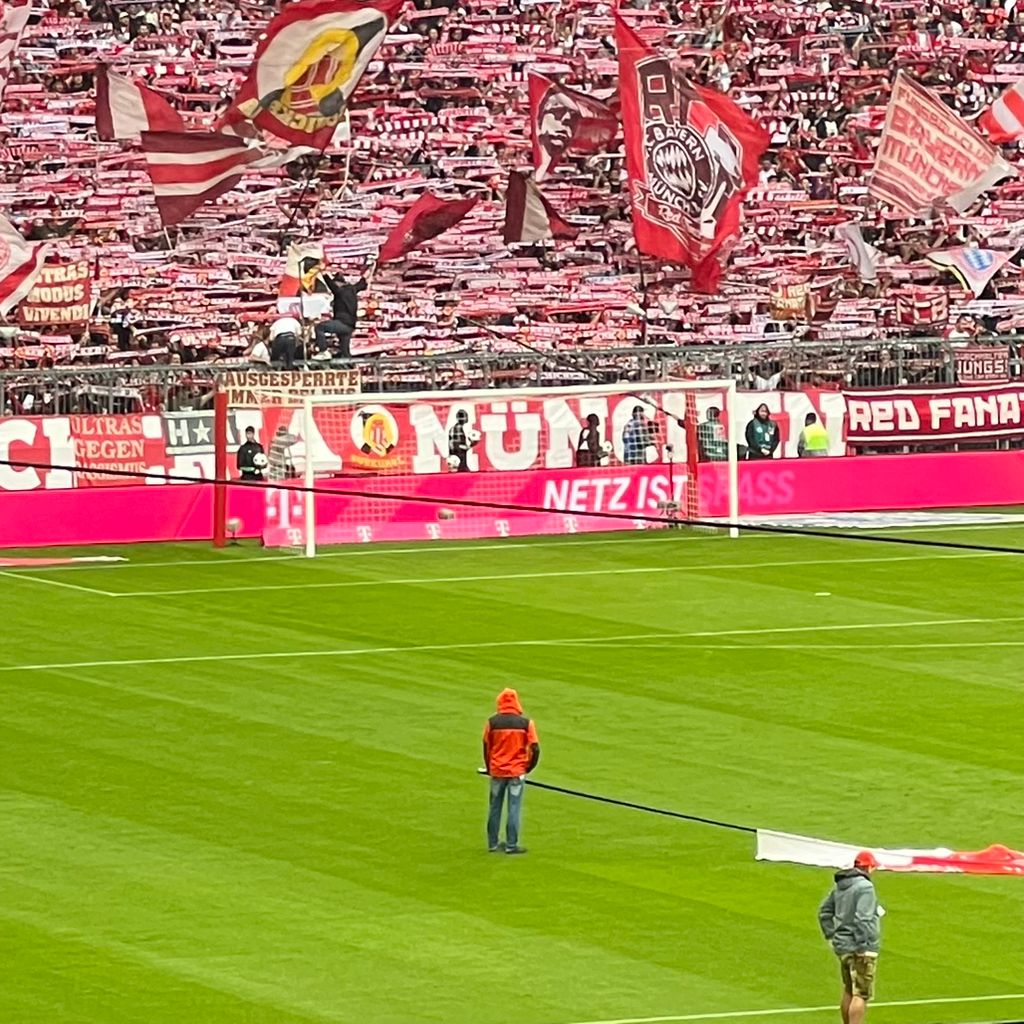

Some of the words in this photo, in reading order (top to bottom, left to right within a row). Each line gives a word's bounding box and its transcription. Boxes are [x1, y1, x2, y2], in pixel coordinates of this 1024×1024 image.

[653, 126, 705, 162] BAYERN
[226, 370, 360, 387] AUSGESPERRTE
[71, 416, 144, 436] ULTRAS
[74, 439, 145, 459] GEGEN
[543, 476, 632, 512] NETZ
[636, 474, 689, 509] IST
